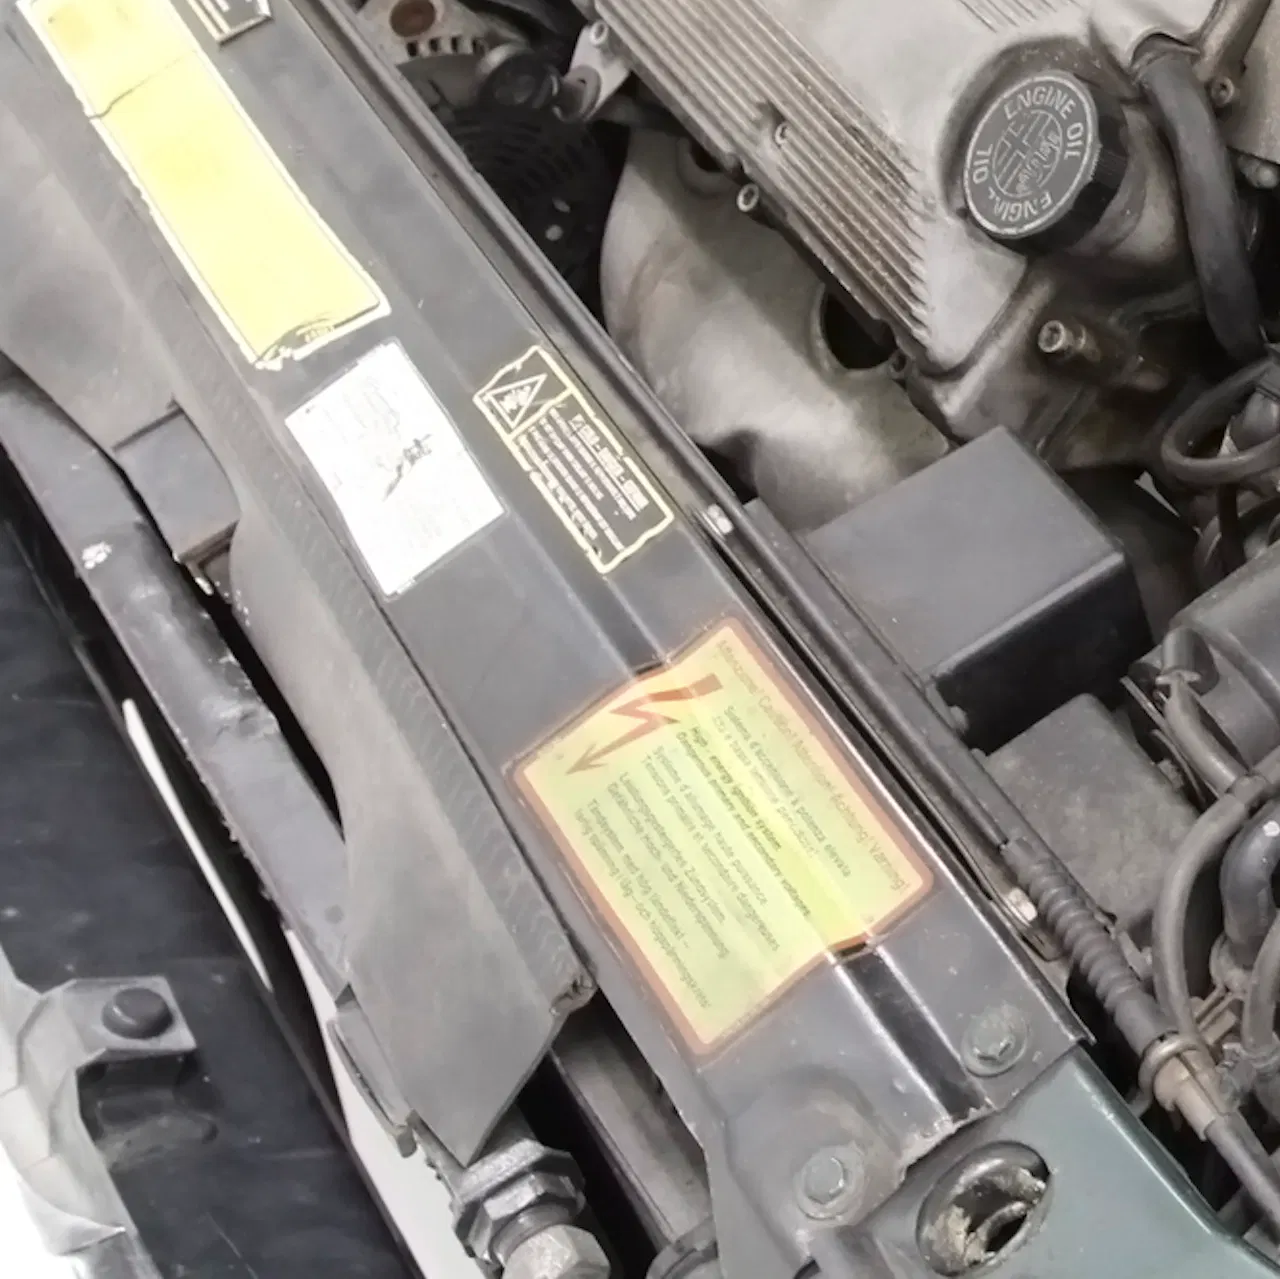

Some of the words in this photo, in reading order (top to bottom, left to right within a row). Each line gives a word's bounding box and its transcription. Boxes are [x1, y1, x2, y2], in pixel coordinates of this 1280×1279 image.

[1004, 86, 1076, 120] ENGINE
[1064, 122, 1085, 160] OIL
[972, 143, 993, 184] OIL
[673, 729, 714, 780] Dangerous
[706, 775, 738, 814] primary
[730, 809, 752, 833] and
[744, 828, 785, 879] secondary
[707, 752, 736, 786] energy
[728, 782, 760, 820] ignition
